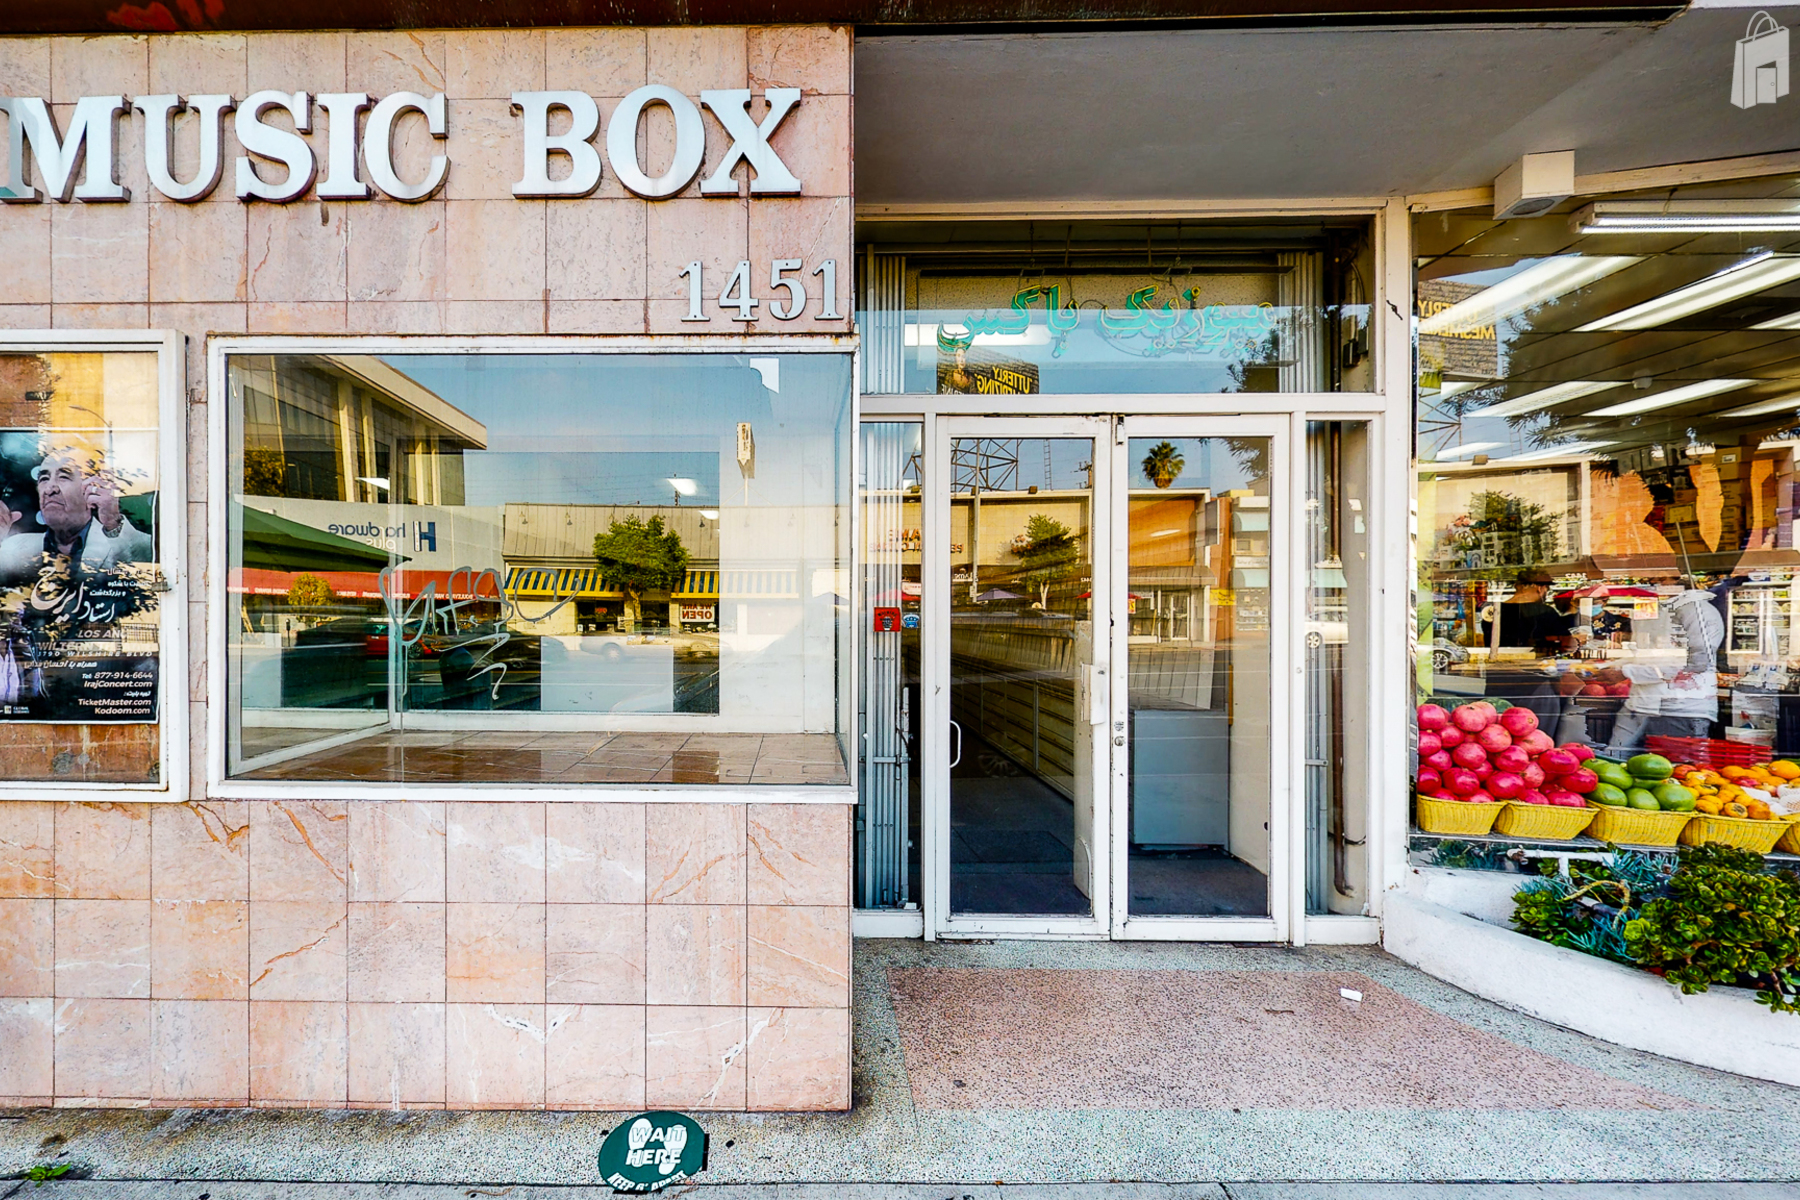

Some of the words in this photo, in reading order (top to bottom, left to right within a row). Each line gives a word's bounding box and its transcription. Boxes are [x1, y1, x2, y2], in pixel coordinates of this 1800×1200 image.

[0, 89, 450, 205] MUSIC
[510, 84, 803, 201] BOX
[678, 257, 847, 324] 1451
[77, 629, 101, 638] LOS
[94, 671, 153, 679] 877-914-6644
[83, 680, 153, 689] IrajConcert.com
[77, 698, 152, 706] TicketMaster.com
[94, 706, 151, 714] Kodoom.com
[631, 1126, 687, 1143] WAIT
[625, 1148, 682, 1166] HERE
[607, 1172, 636, 1191] KEEP
